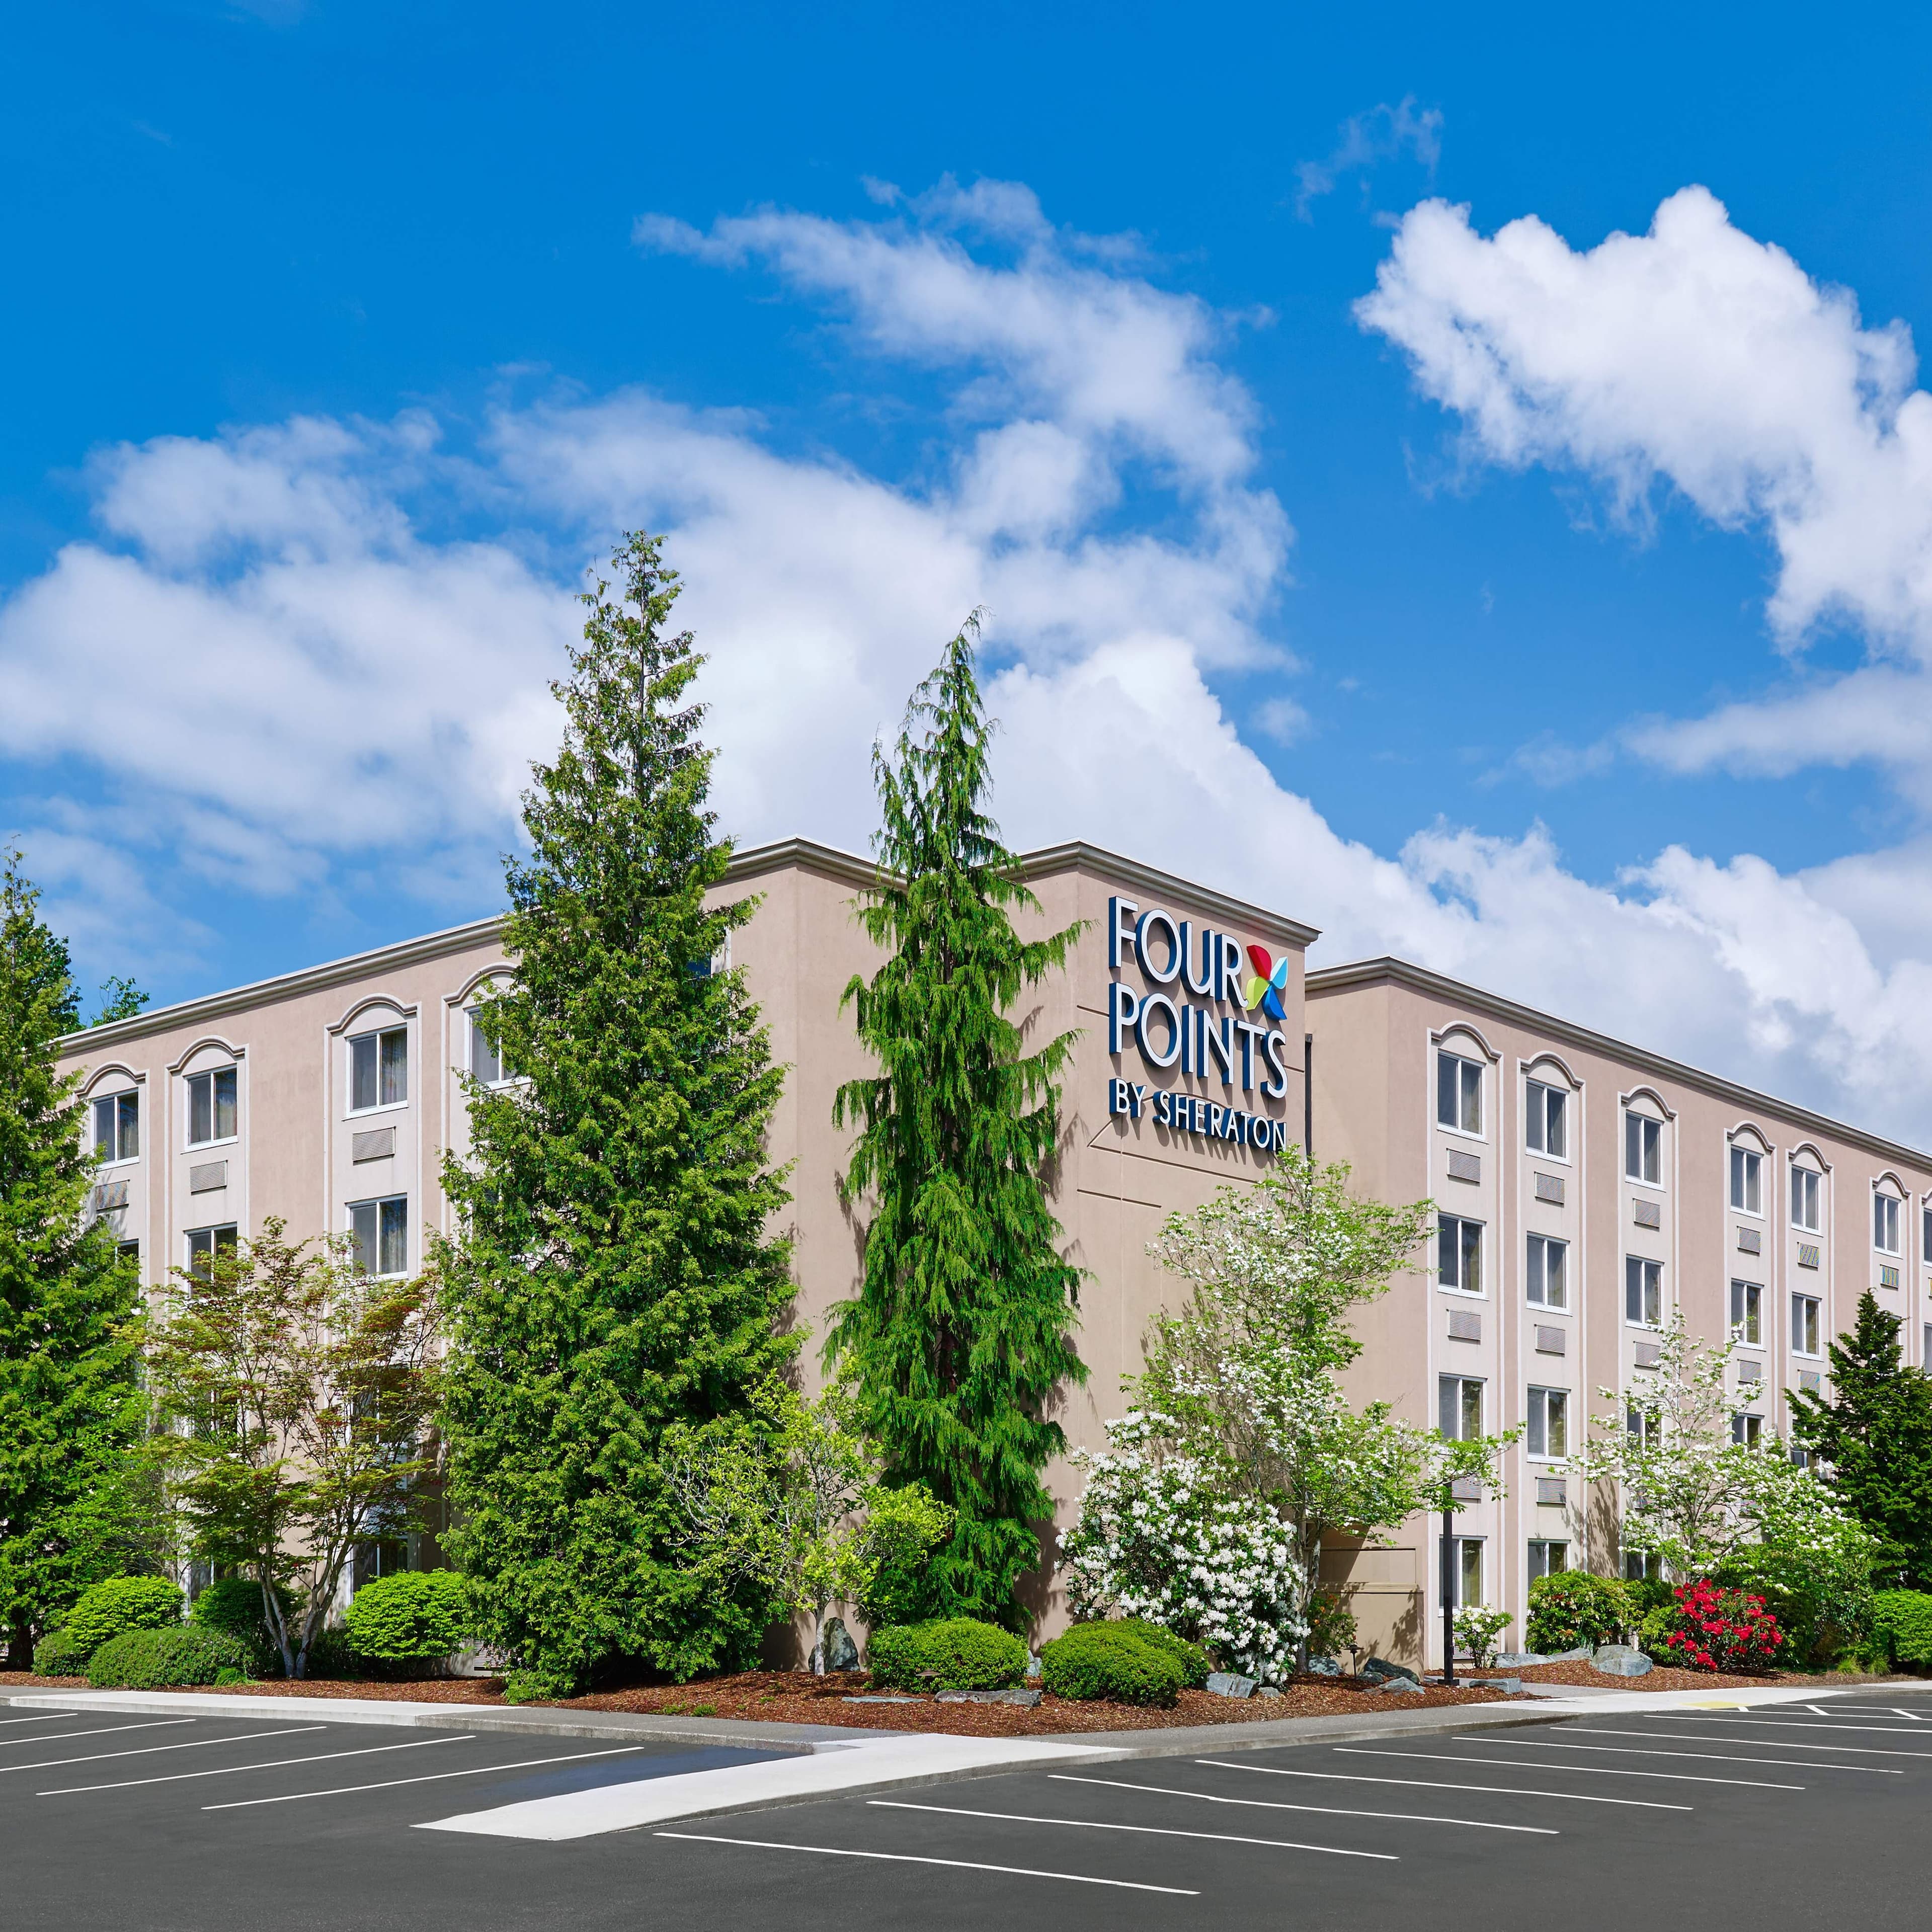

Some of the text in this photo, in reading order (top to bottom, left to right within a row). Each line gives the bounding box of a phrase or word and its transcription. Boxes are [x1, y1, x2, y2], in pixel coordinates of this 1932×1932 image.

[1109, 896, 1248, 1007] FOUR
[1109, 982, 1288, 1098] POINTS
[1109, 1078, 1286, 1152] BY SHERATON
